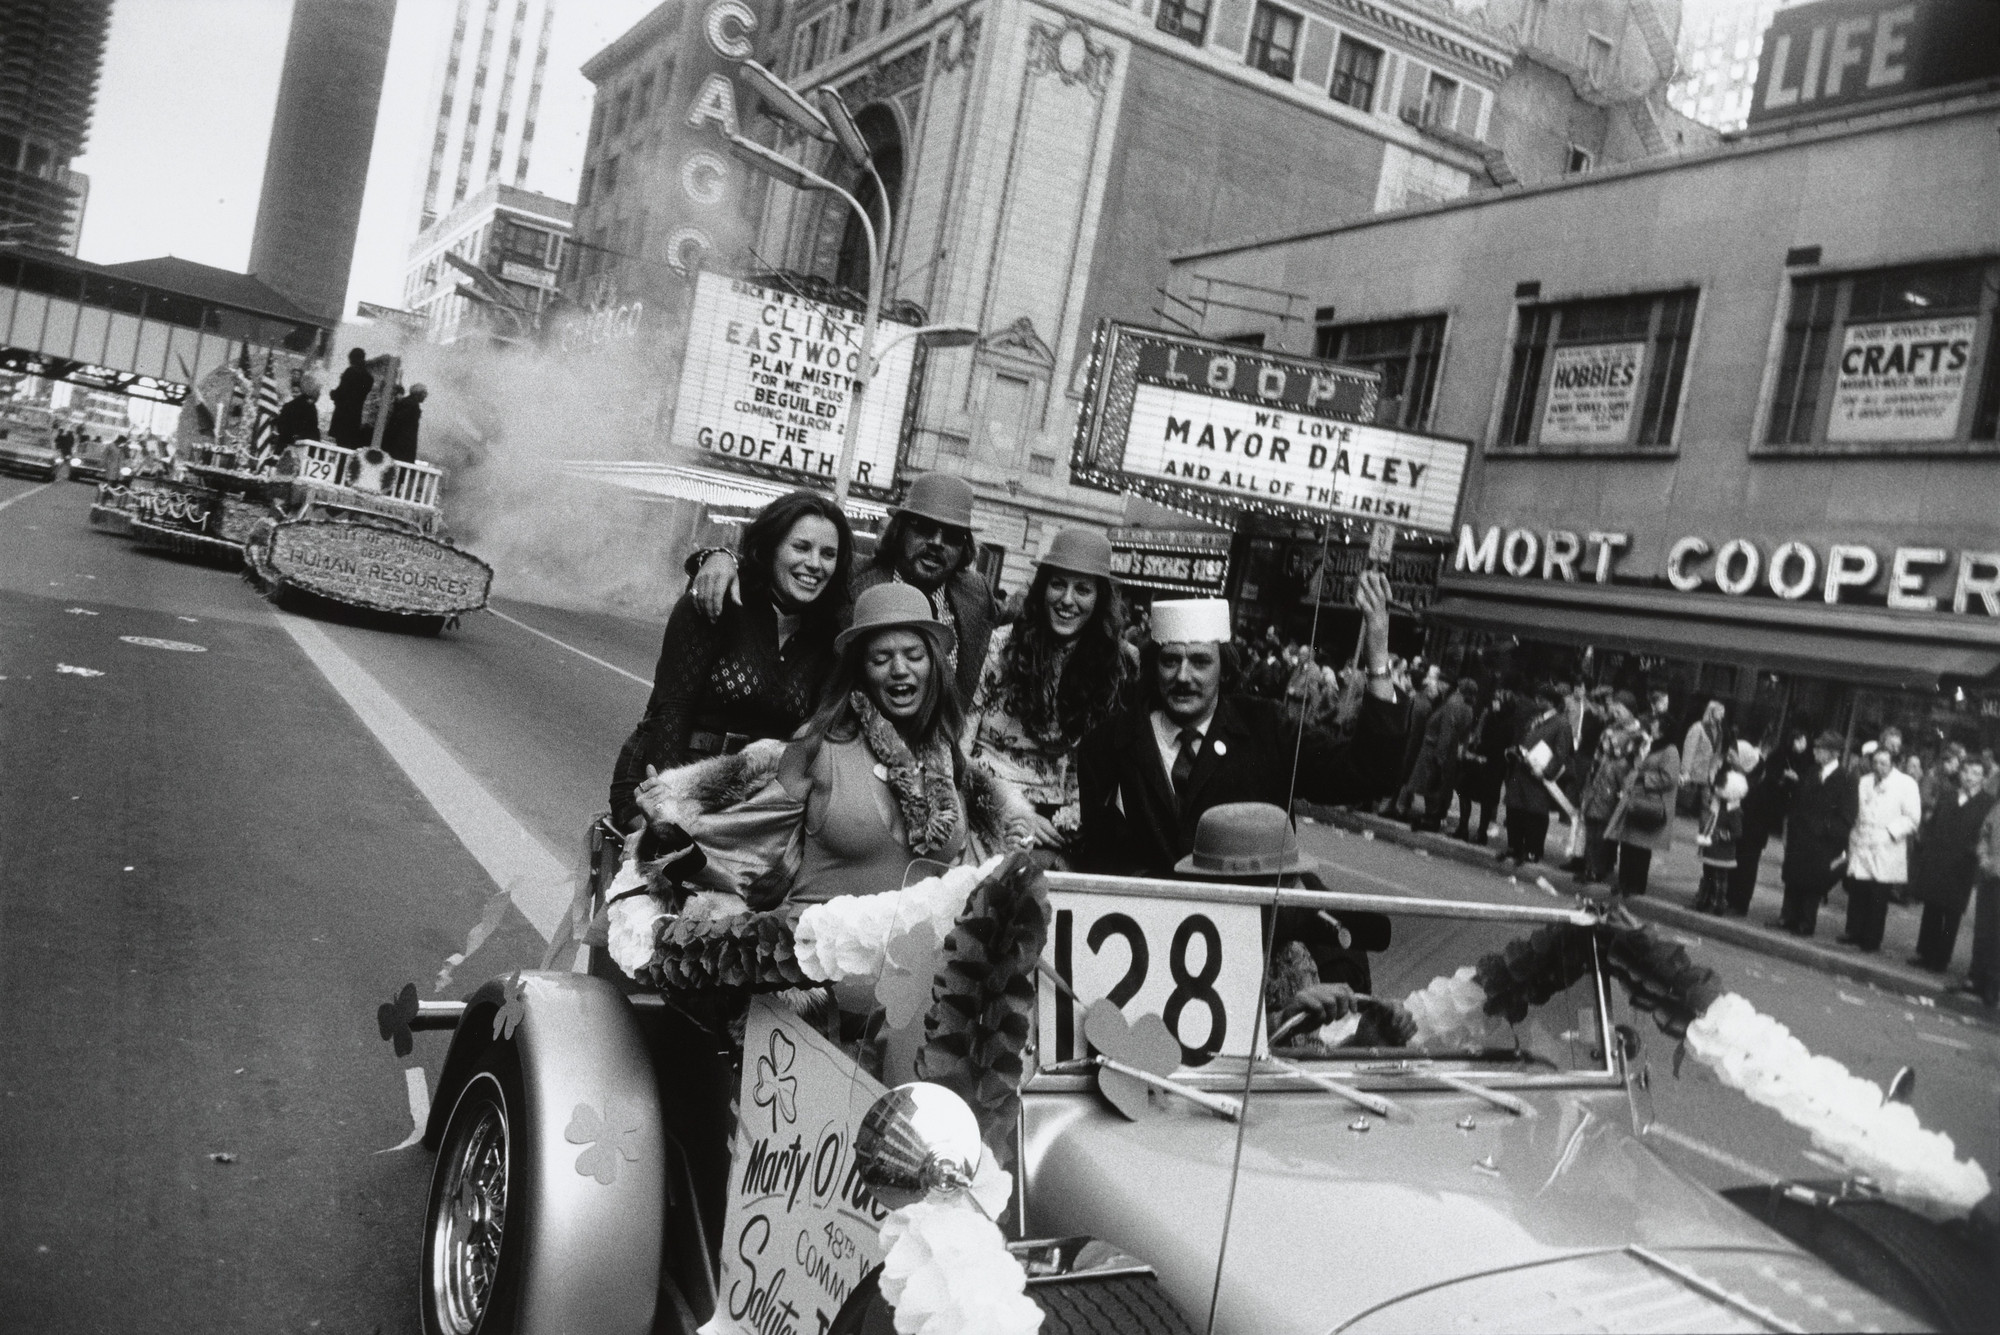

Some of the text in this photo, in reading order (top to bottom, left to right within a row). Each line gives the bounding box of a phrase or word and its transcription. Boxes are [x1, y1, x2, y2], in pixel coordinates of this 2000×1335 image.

[1764, 5, 1915, 110] LIFE
[762, 304, 856, 346] CLINT
[801, 365, 852, 391] MISTY
[1166, 348, 1336, 407] LOOP
[1553, 362, 1636, 389] HOBBIES
[1841, 340, 1969, 375] CRAFTS
[751, 371, 778, 388] FOR
[812, 386, 844, 402] PLUS
[734, 400, 782, 421] COMING
[787, 411, 833, 432] MARCH
[1255, 411, 1353, 442] WE LOVE
[302, 460, 332, 481] 129
[1164, 415, 1428, 488] MAYOR DALEY
[1163, 460, 1412, 519] AND ALL OF THE IRISH
[289, 548, 357, 575] HUMAN
[367, 563, 470, 596] RESOURCES
[1454, 523, 1634, 585] MORT
[1666, 534, 2000, 617] COOPER
[1053, 908, 1229, 1068] 128
[741, 1133, 812, 1213] Marty
